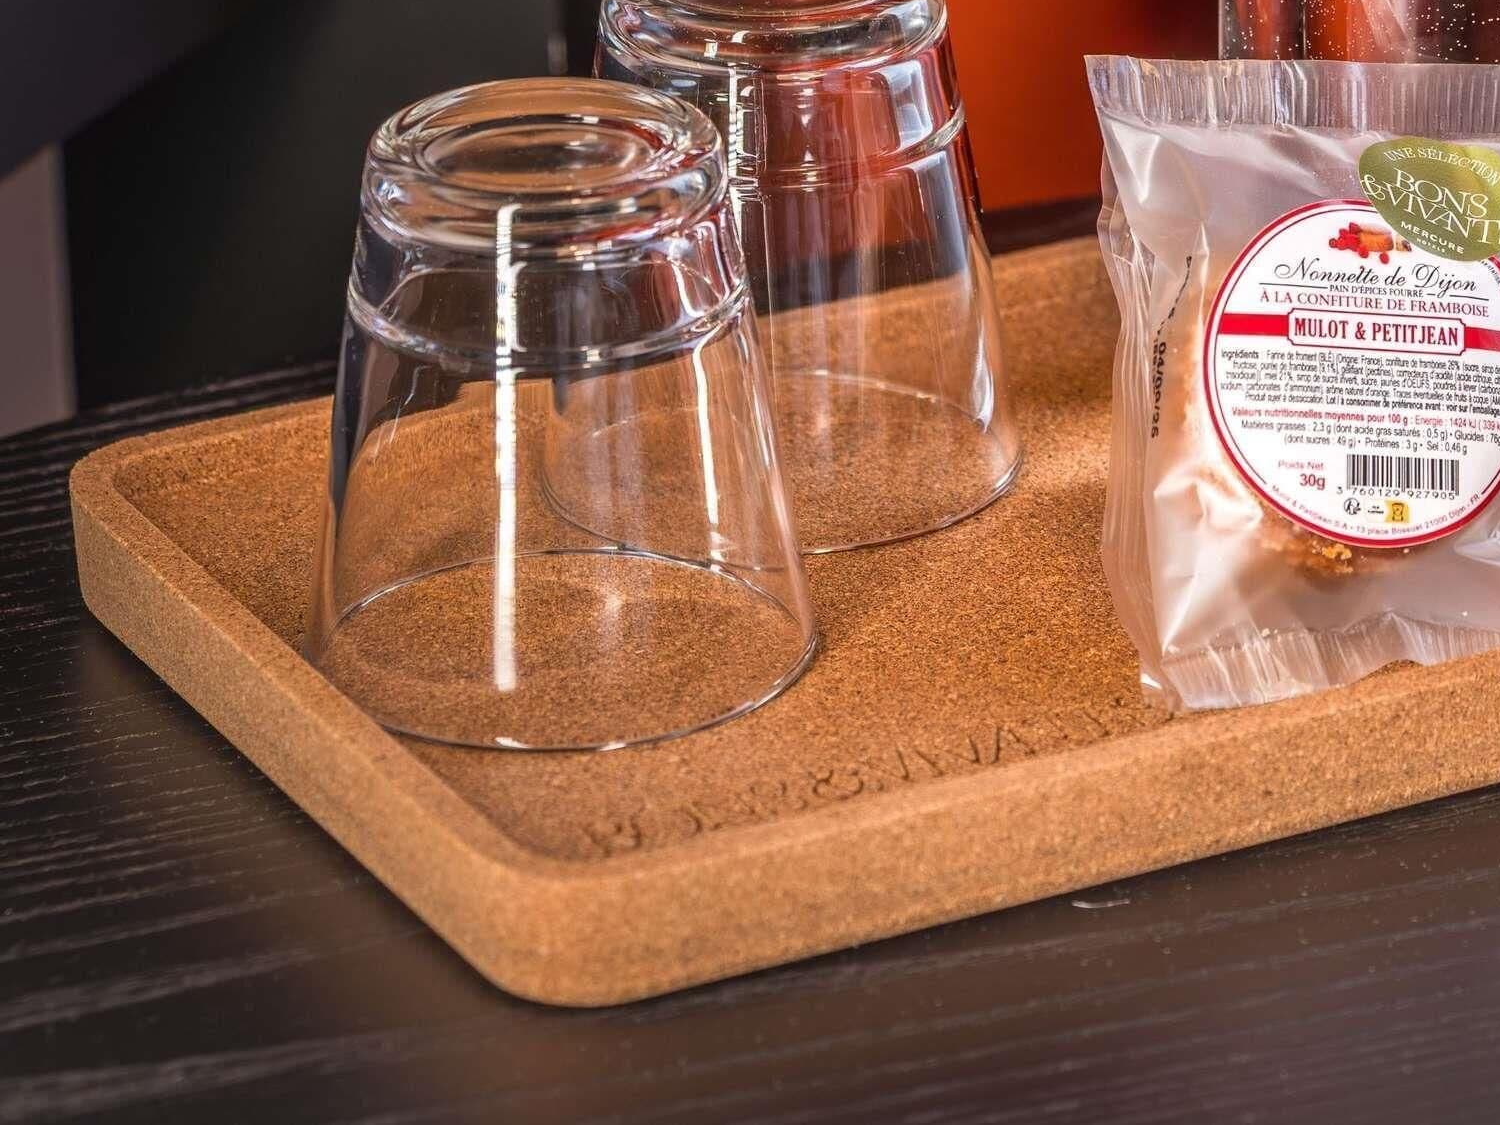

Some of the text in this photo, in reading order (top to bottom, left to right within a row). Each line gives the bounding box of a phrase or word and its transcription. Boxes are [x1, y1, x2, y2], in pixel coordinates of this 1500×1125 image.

[1383, 147, 1416, 163] UNE
[1394, 167, 1489, 219] BONS
[1401, 221, 1465, 254] MERCURE
[1274, 257, 1380, 285] Nonnette
[1384, 266, 1406, 286] de
[1411, 263, 1477, 298] Dijon
[1329, 284, 1349, 293] PAIN
[1275, 291, 1293, 304] LA
[1297, 293, 1383, 310] CONFITURE
[1387, 298, 1406, 311] DE
[1410, 300, 1490, 318] FRAMBOISE
[1294, 317, 1459, 347] MULOT & PETITJEAN
[1325, 412, 1364, 423] moyennes
[1367, 414, 1385, 425] pour
[1388, 413, 1400, 424] 100
[1375, 428, 1393, 438] gras
[1454, 430, 1484, 443] Glucides
[1300, 473, 1326, 490] 30g
